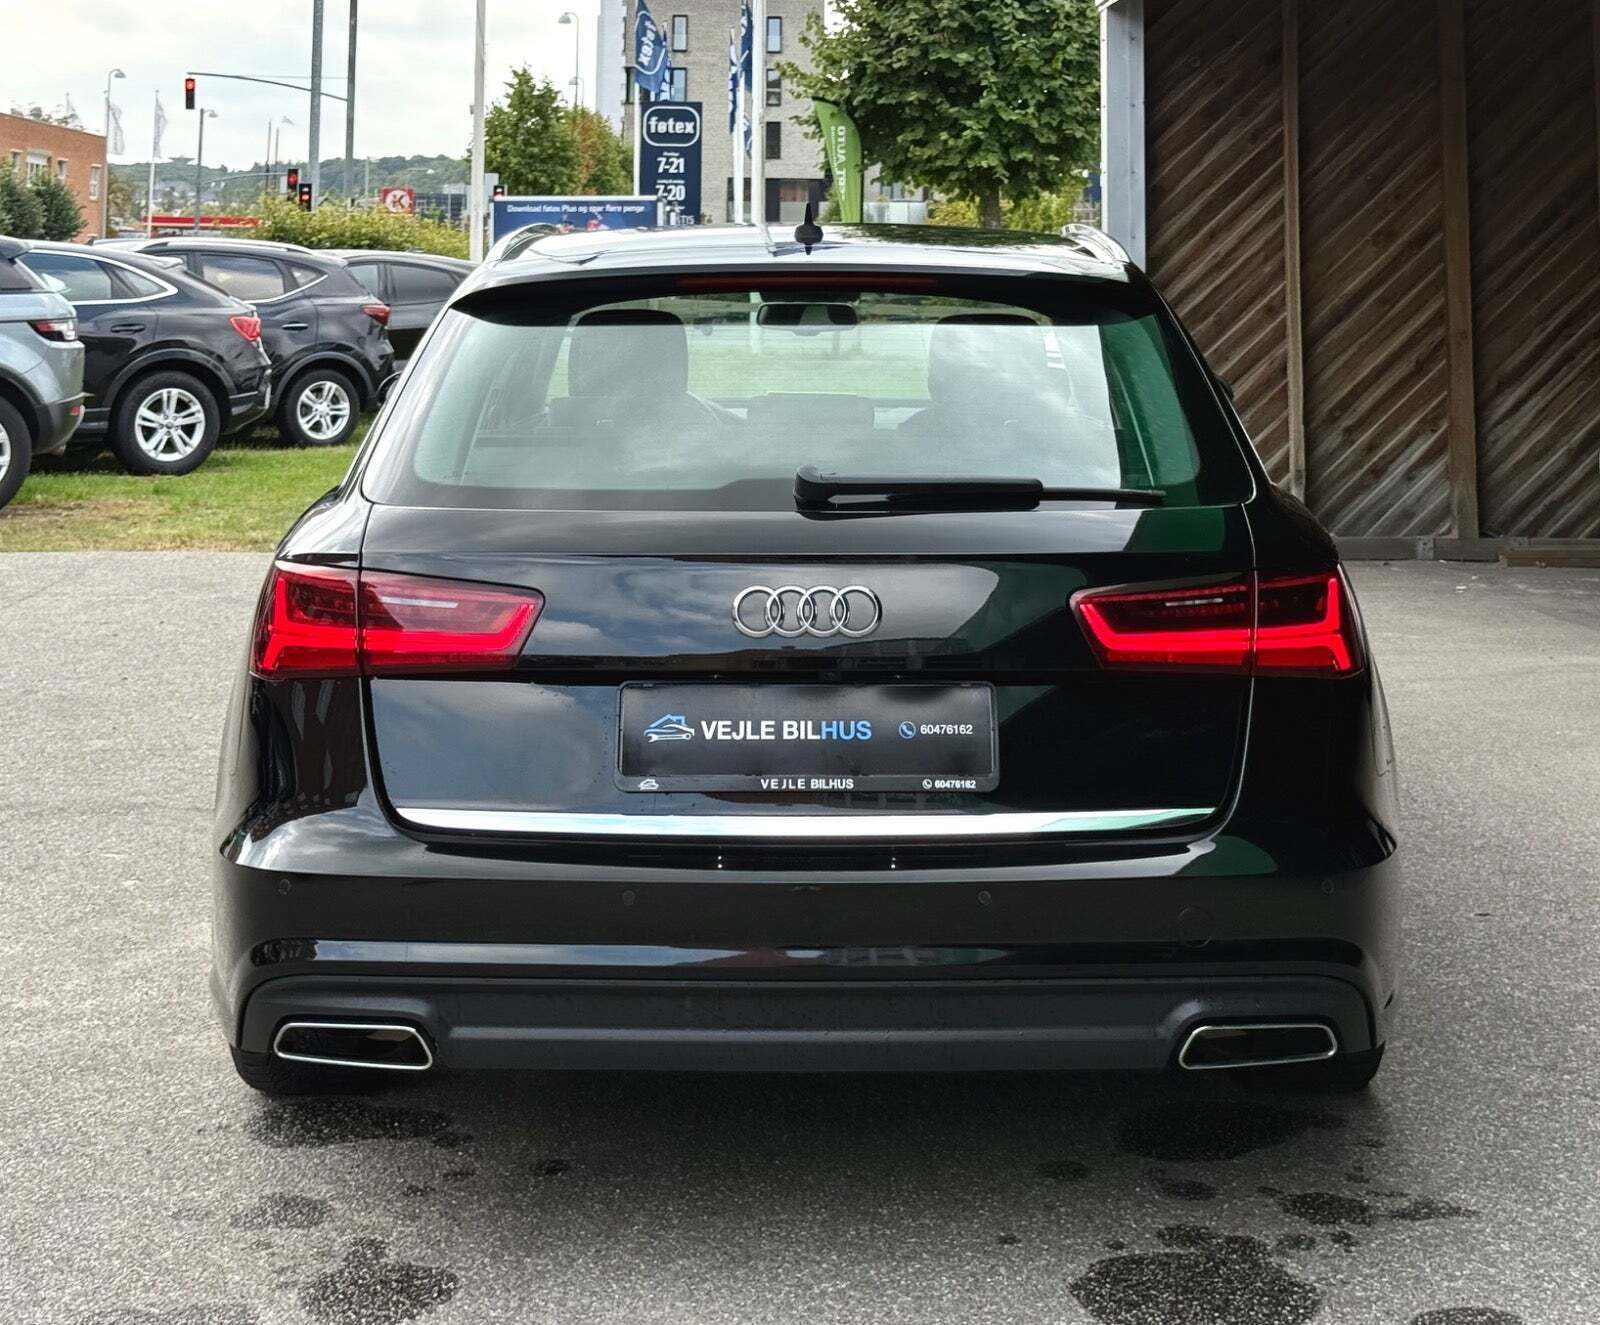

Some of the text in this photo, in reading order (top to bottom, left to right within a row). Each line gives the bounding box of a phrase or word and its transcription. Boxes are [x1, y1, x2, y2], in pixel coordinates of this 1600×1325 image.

[648, 116, 695, 134] føtex
[656, 157, 685, 173] 7-21
[655, 185, 686, 201] 7-20
[392, 194, 406, 209] K
[701, 720, 872, 740] VEJLE BILHUS
[920, 724, 973, 735] 60476162
[760, 778, 854, 789] VEJLE BILHUS
[934, 779, 977, 789] 60476162
